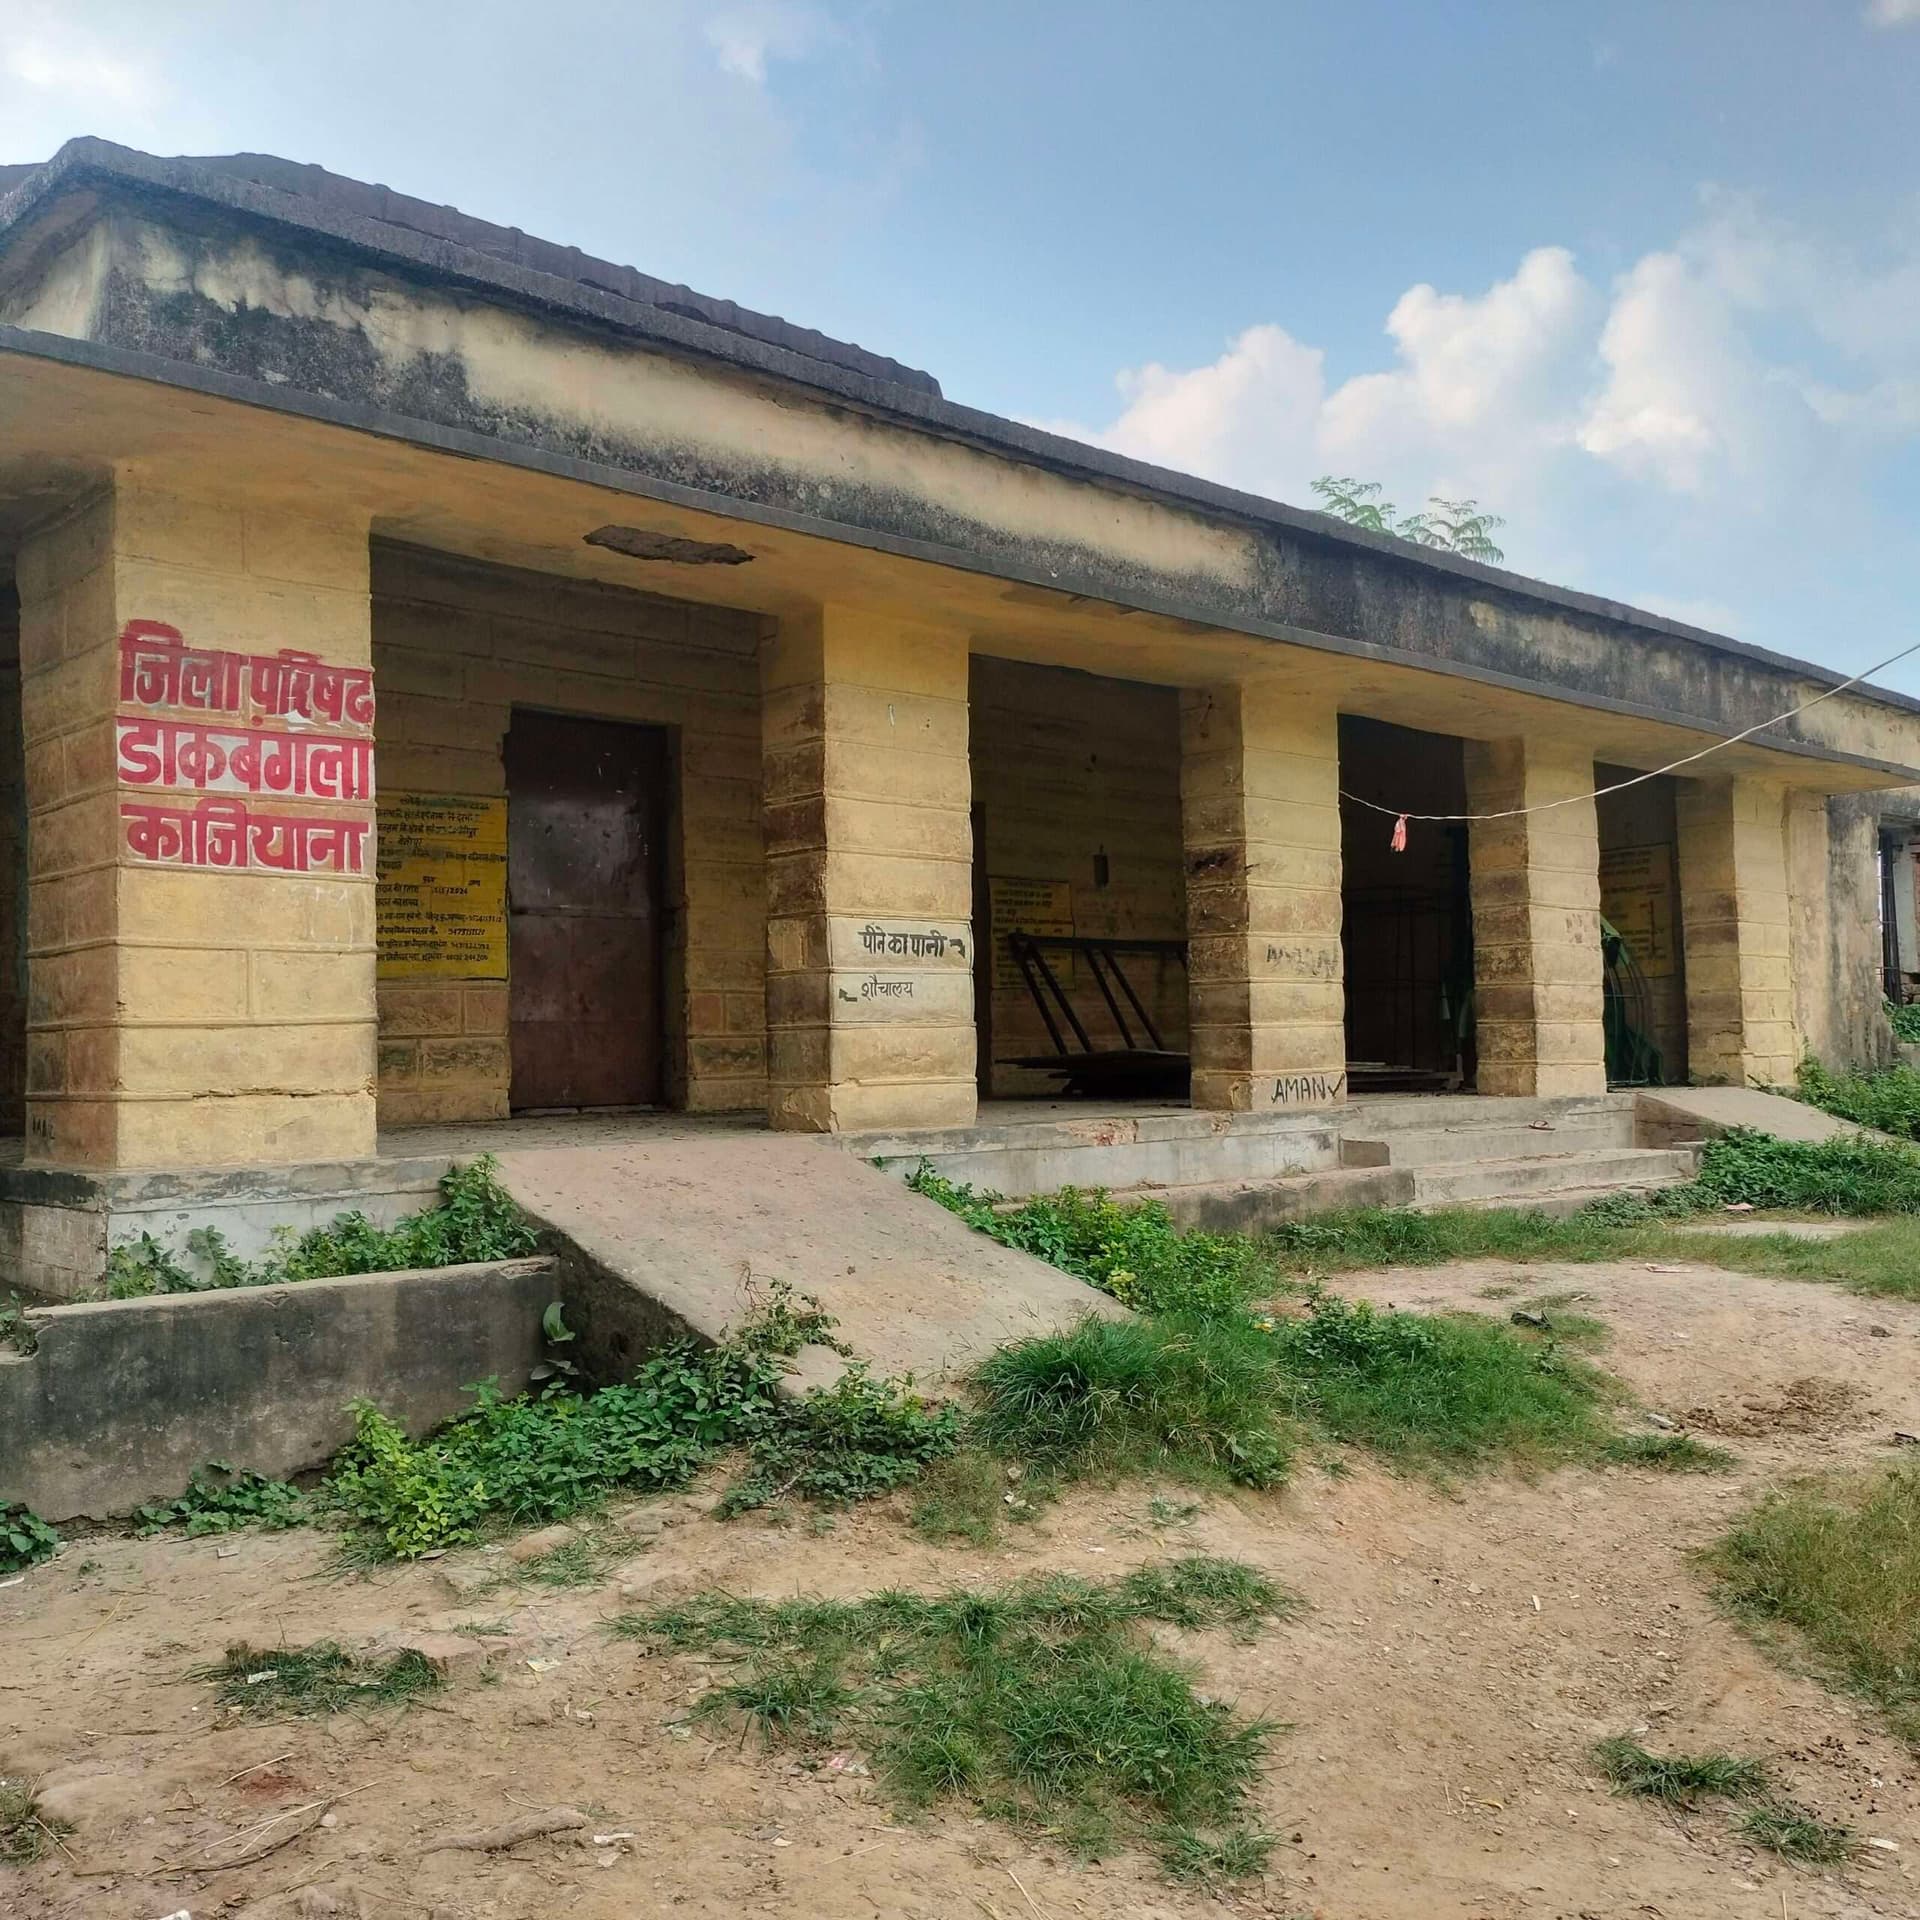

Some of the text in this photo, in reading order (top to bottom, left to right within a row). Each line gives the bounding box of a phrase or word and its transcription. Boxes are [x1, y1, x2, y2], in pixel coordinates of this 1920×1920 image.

[119, 618, 242, 711] जिला
[120, 797, 369, 873] काजियाना
[858, 924, 948, 958] पीने का पानी
[861, 974, 914, 1000] शौचालय
[1272, 1076, 1326, 1103] AMAN
